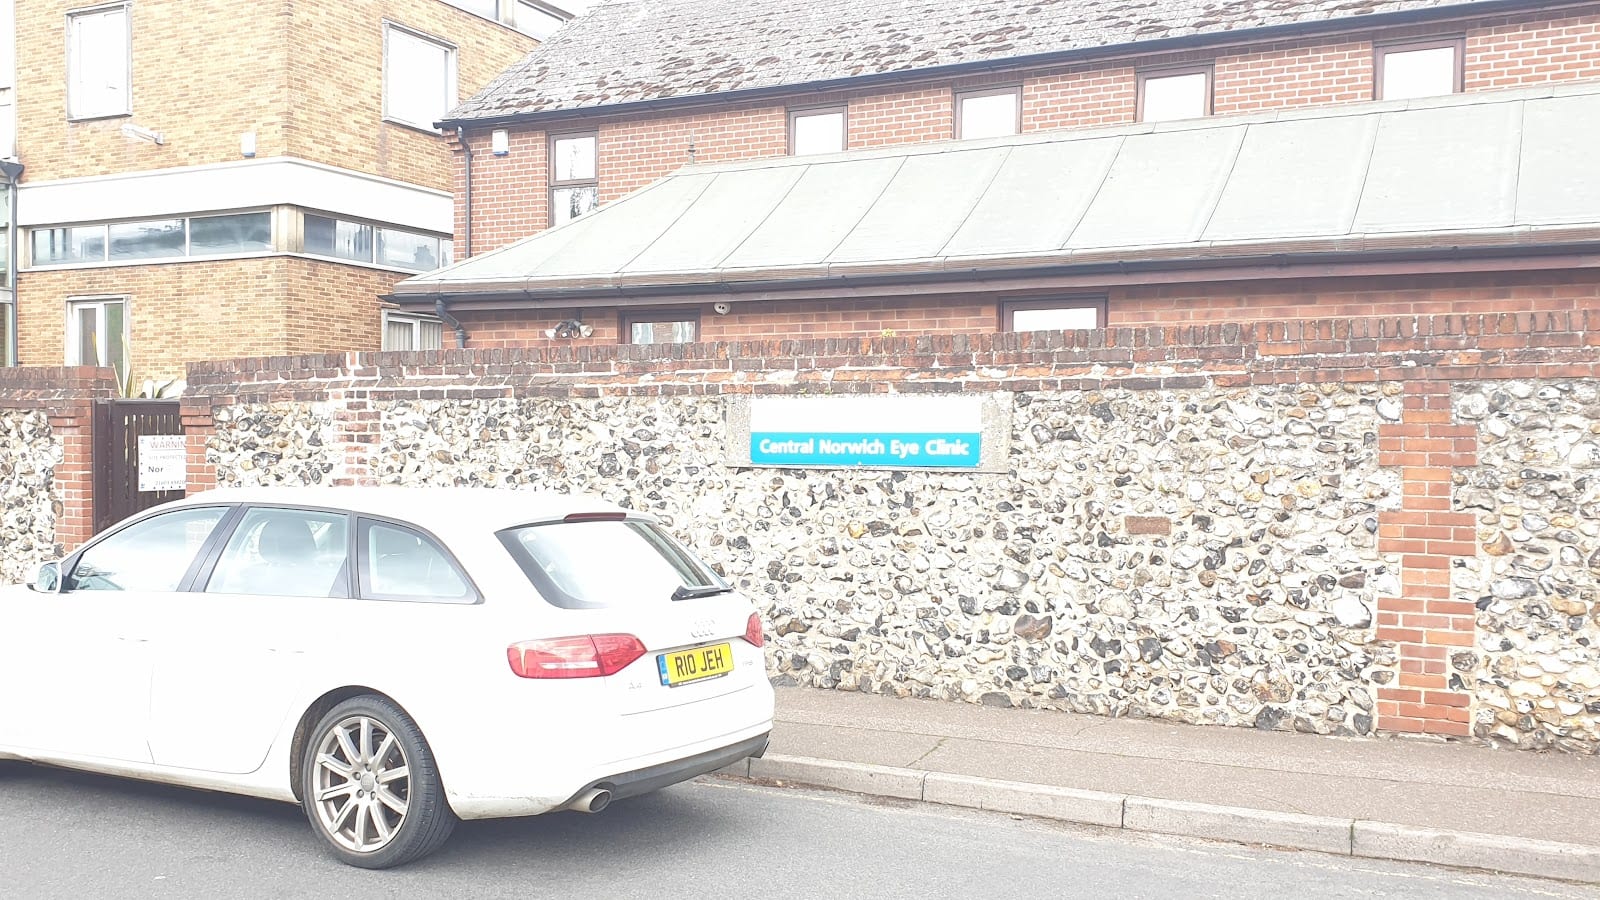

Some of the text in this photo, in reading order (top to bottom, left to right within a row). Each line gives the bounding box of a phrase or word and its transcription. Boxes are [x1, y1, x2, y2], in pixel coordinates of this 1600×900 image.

[149, 440, 186, 448] WARNIN
[759, 438, 970, 459] Central Norwich Eye Clinic
[700, 648, 724, 672] JEH
